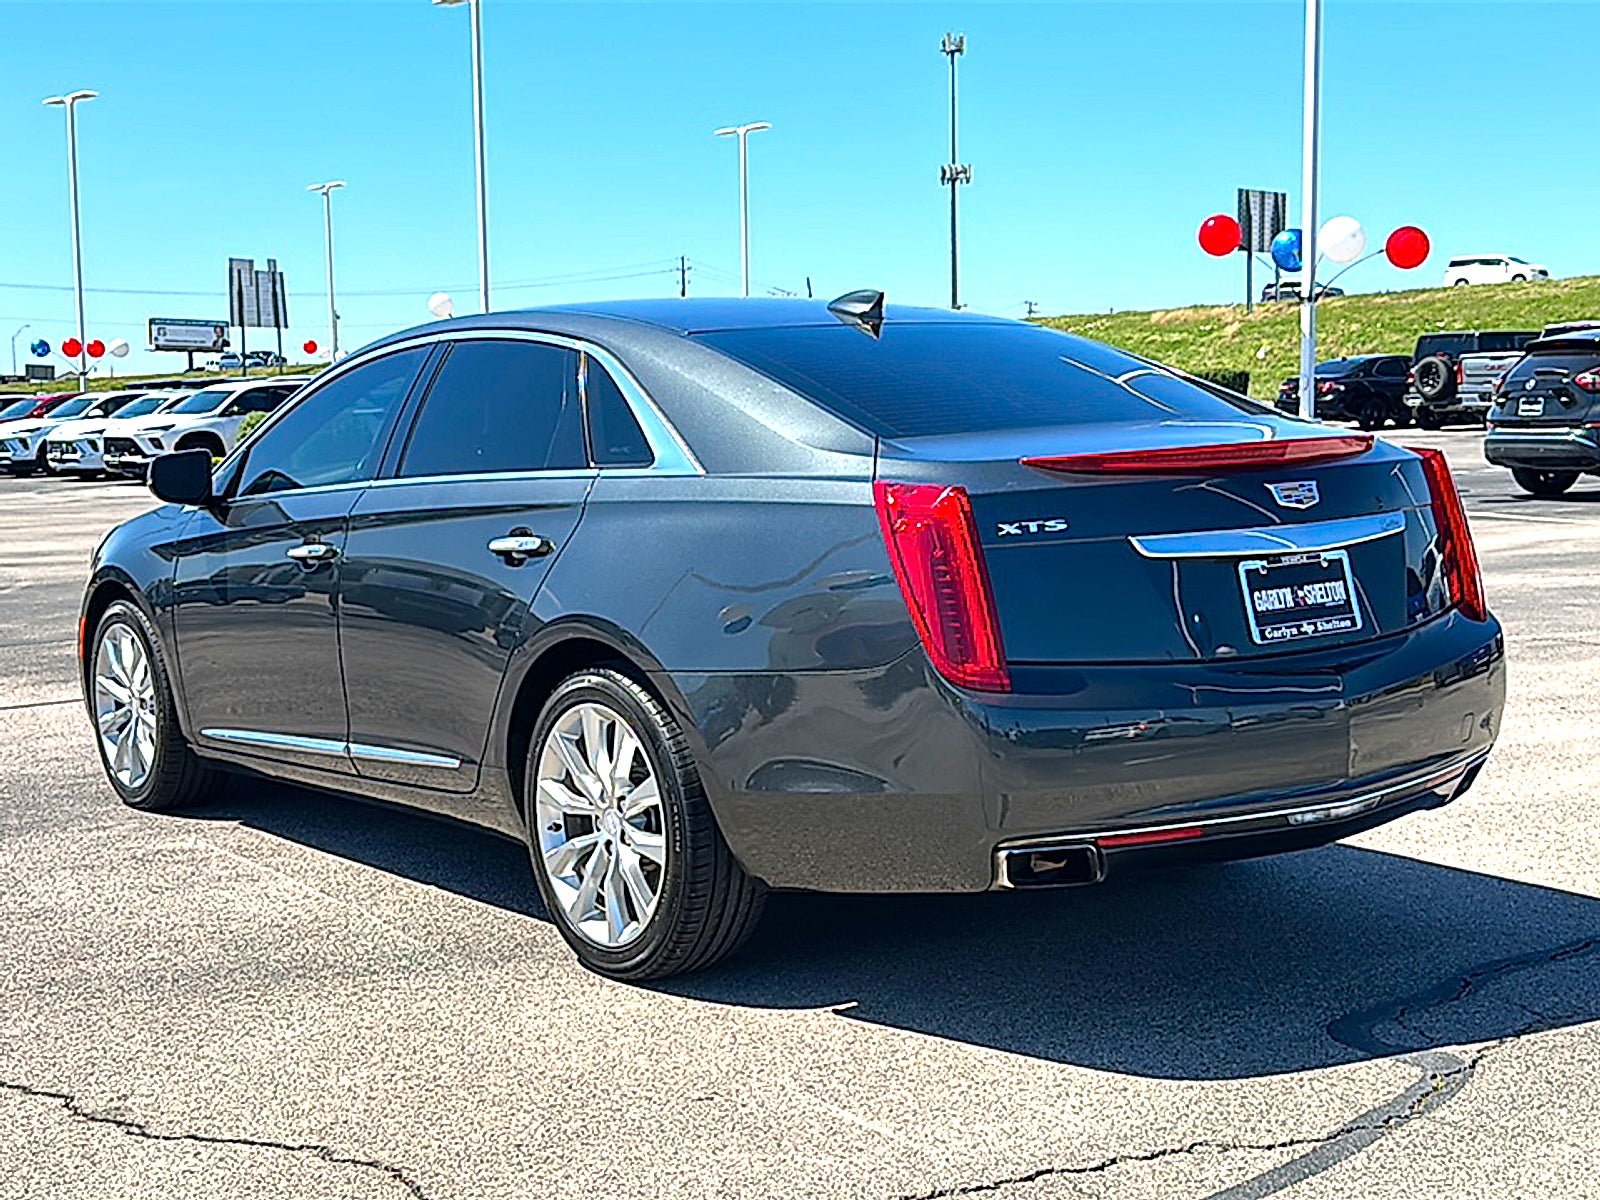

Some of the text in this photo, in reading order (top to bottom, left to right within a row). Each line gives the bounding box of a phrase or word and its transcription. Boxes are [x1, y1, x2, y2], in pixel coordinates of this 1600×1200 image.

[997, 518, 1068, 537] XTS
[1253, 580, 1346, 612] GARLYN SHELTON
[1316, 619, 1351, 632] Shelton
